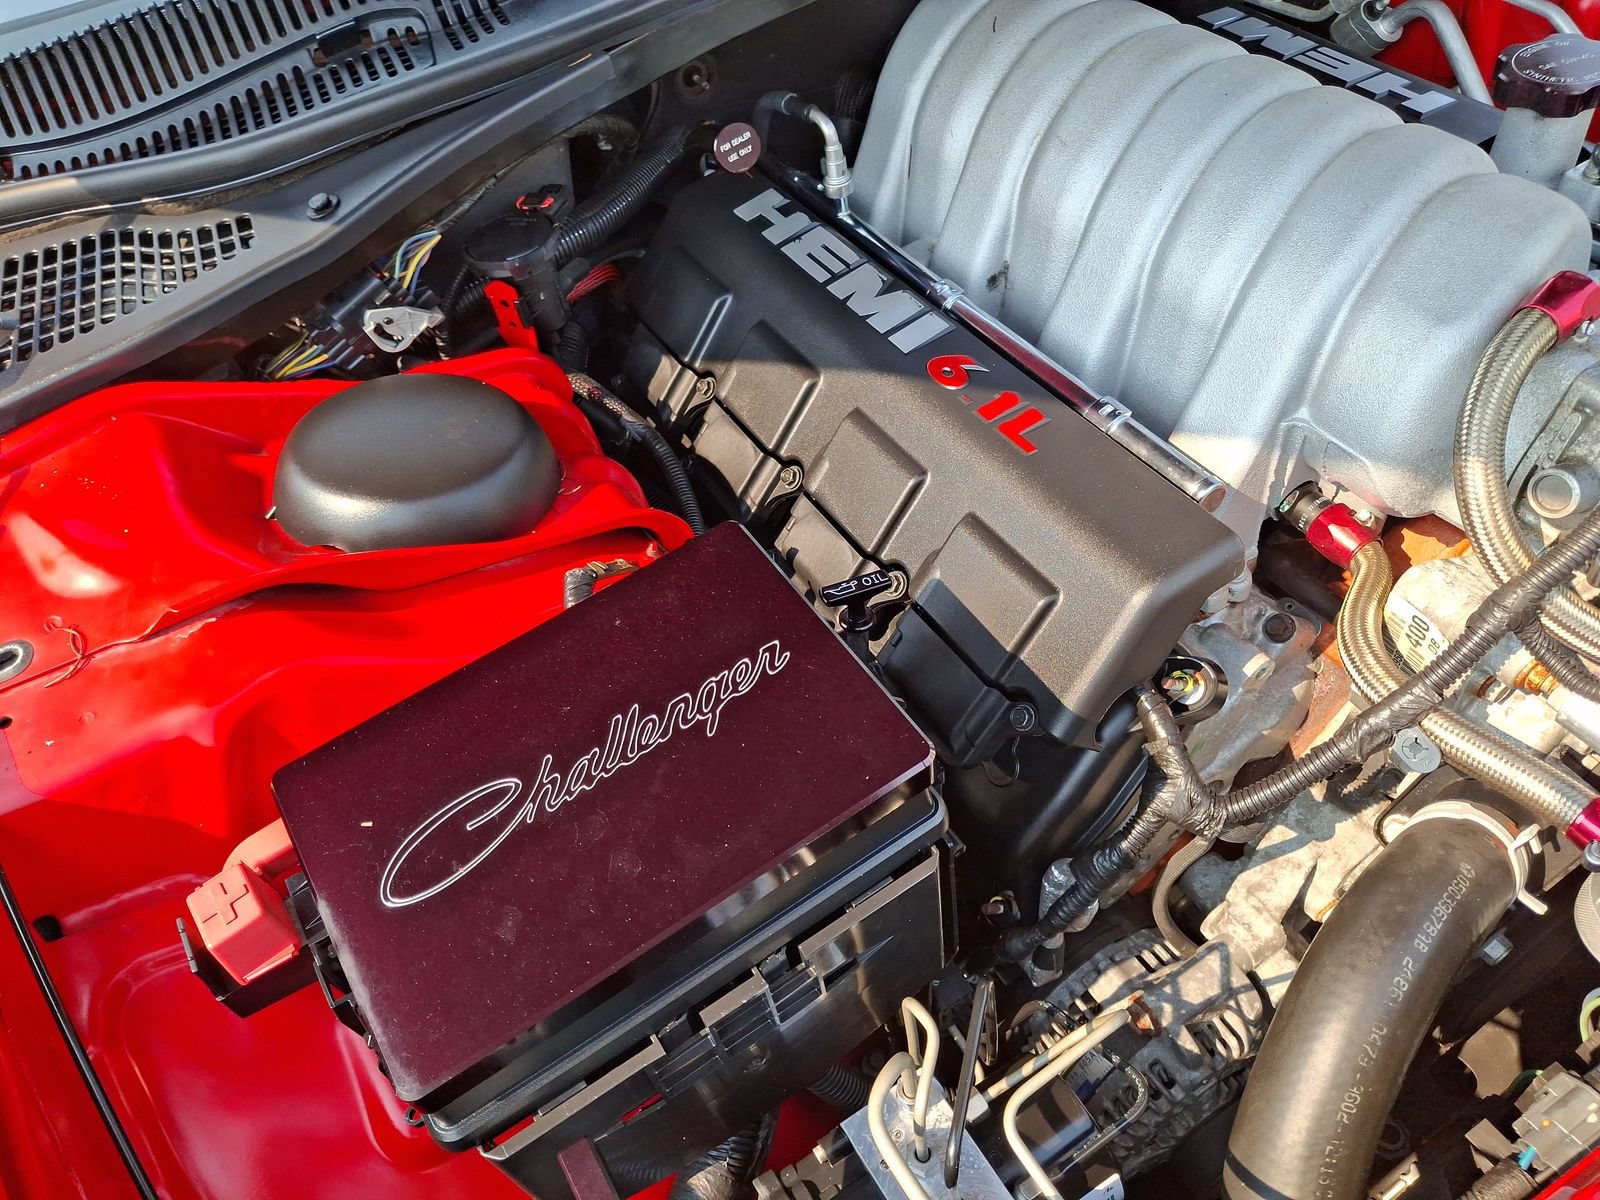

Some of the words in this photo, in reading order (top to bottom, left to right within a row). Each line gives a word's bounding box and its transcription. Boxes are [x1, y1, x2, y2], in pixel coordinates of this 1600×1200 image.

[1197, 6, 1458, 120] HEMI
[720, 142, 732, 153] FOR
[731, 131, 752, 147] DEALER
[727, 152, 740, 163] USE
[739, 144, 753, 157] ONLY
[733, 187, 953, 354] HEMI
[926, 354, 1050, 455] 6.1L
[862, 573, 889, 586] OIL
[1405, 614, 1430, 649] 400
[379, 640, 791, 907] Challenger
